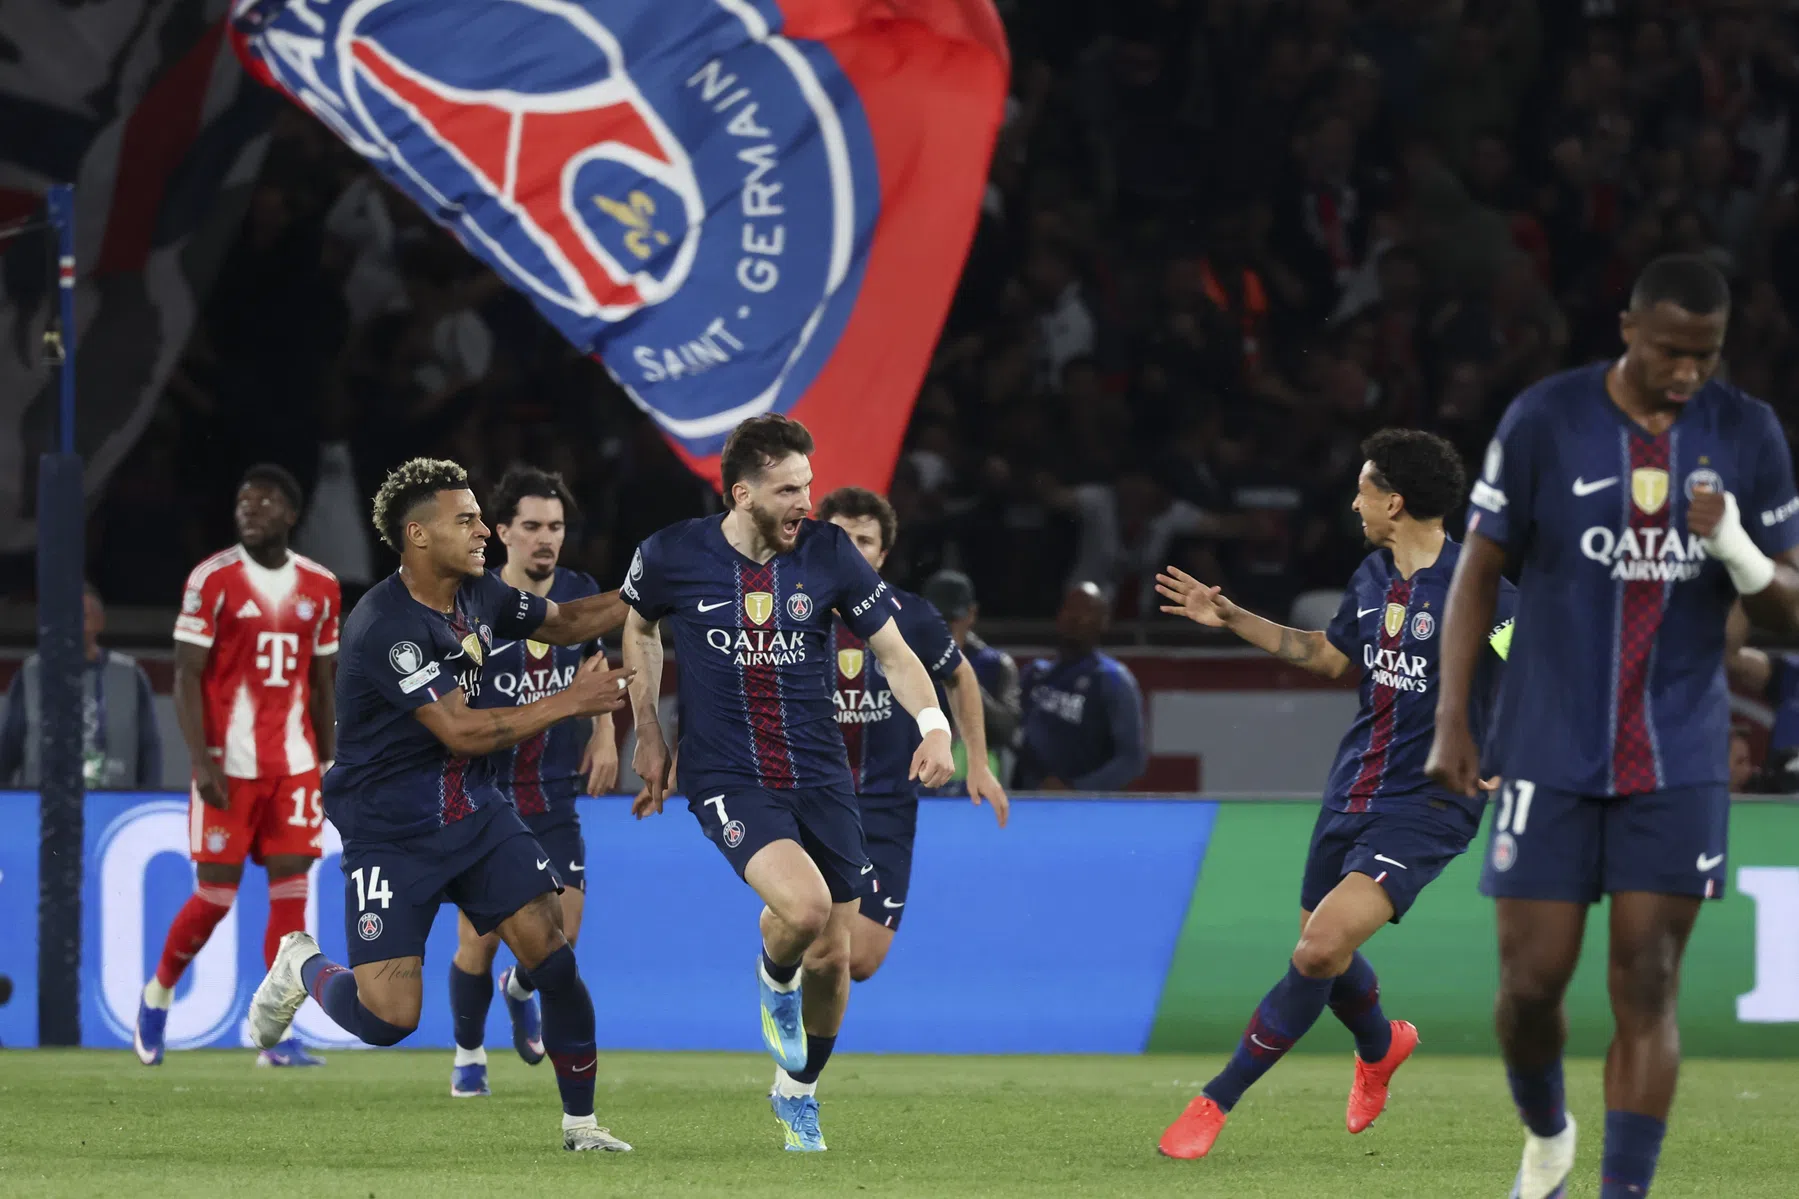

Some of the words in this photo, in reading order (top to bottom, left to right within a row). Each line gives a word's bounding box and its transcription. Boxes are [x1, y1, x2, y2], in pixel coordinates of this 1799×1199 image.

[686, 59, 786, 293] GERMAIN
[633, 317, 744, 382] SAINT
[706, 627, 806, 655] QATAR
[733, 646, 806, 666] AIRWAYS
[256, 631, 299, 687] T
[1363, 643, 1427, 679] QATAR
[494, 665, 576, 698] QATAR
[1371, 669, 1428, 693] AIRWAYS
[832, 689, 893, 711] ATAR
[288, 786, 324, 828] 19
[704, 794, 730, 826] 7
[351, 866, 393, 912] 14
